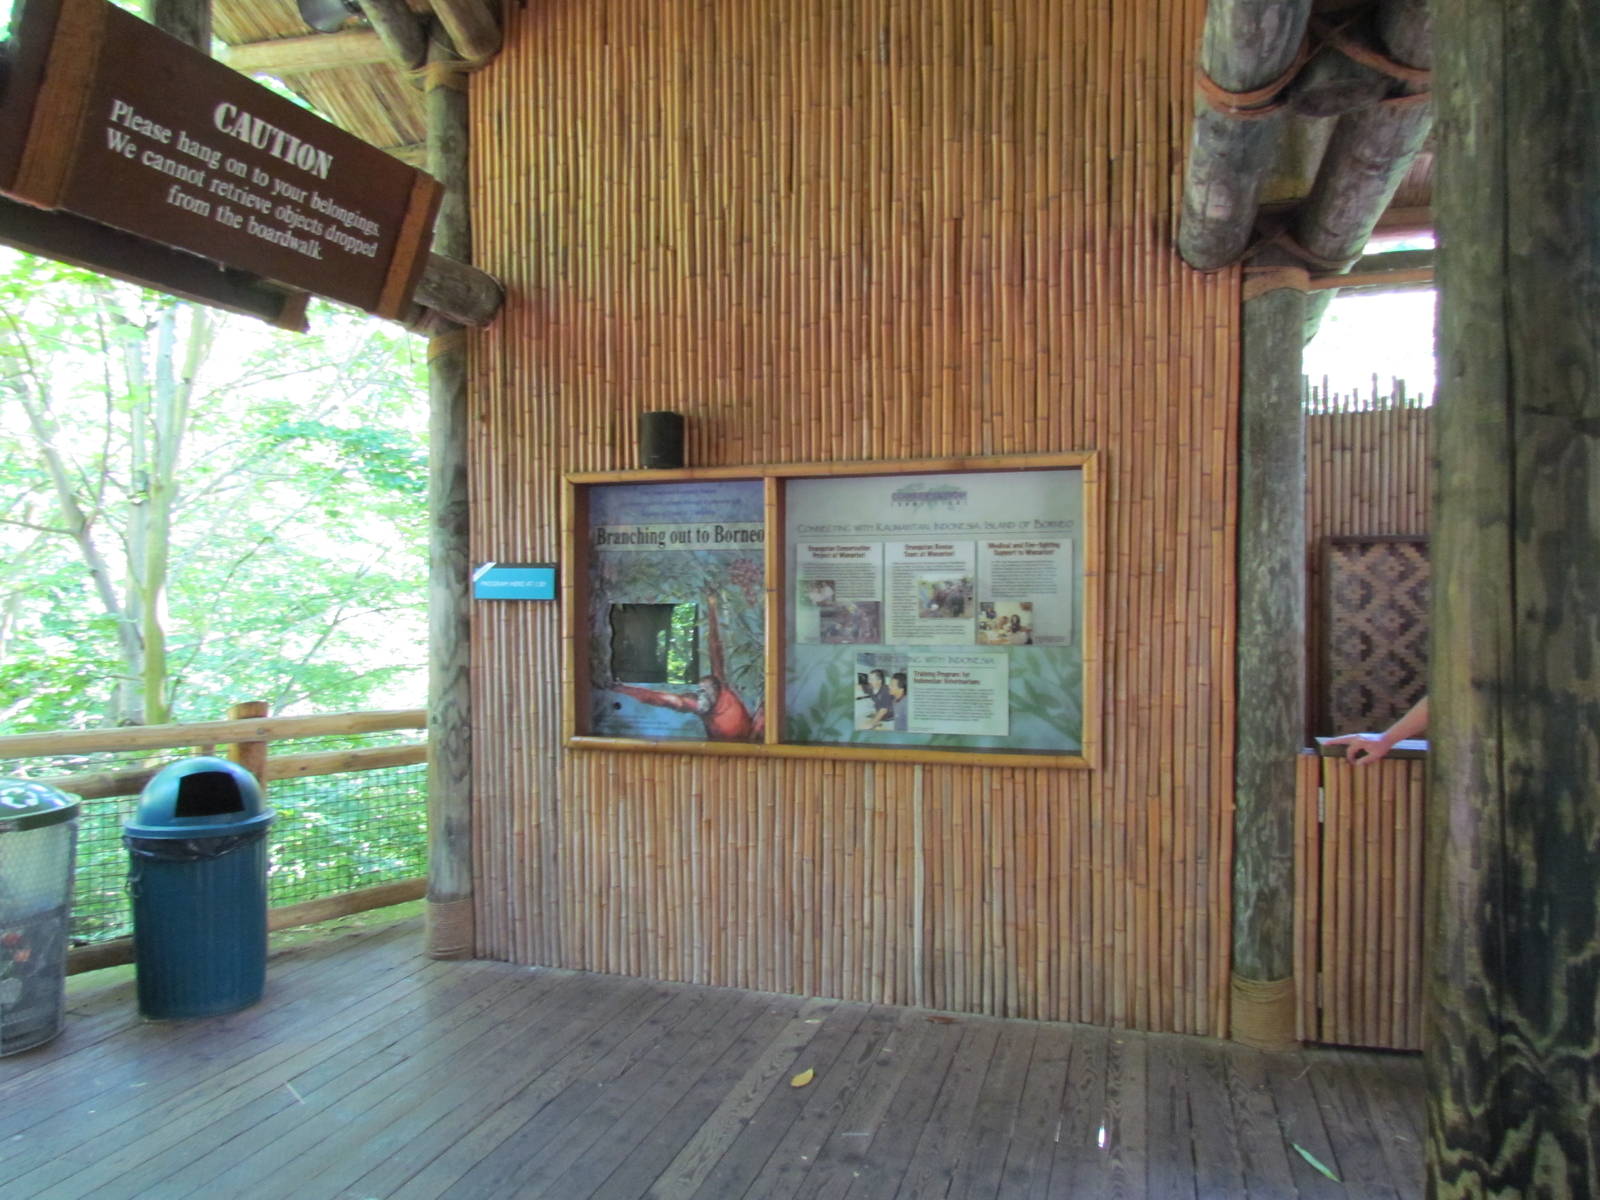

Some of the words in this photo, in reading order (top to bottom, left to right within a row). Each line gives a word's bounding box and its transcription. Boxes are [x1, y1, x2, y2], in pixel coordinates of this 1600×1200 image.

[109, 99, 172, 145] Please
[176, 131, 223, 171] hang
[225, 158, 249, 178] on
[250, 168, 270, 188] to
[271, 178, 309, 204] your
[214, 101, 334, 180] CAUTION
[106, 128, 138, 159] We
[141, 151, 207, 188] cannot
[209, 179, 273, 215] retrieve
[274, 205, 325, 236] objects
[324, 225, 379, 259] dropped
[166, 185, 212, 218] from
[216, 206, 244, 230] the
[596, 526, 667, 548] Branching
[670, 528, 693, 544] out
[695, 526, 711, 544] to
[713, 524, 764, 544] Borneo
